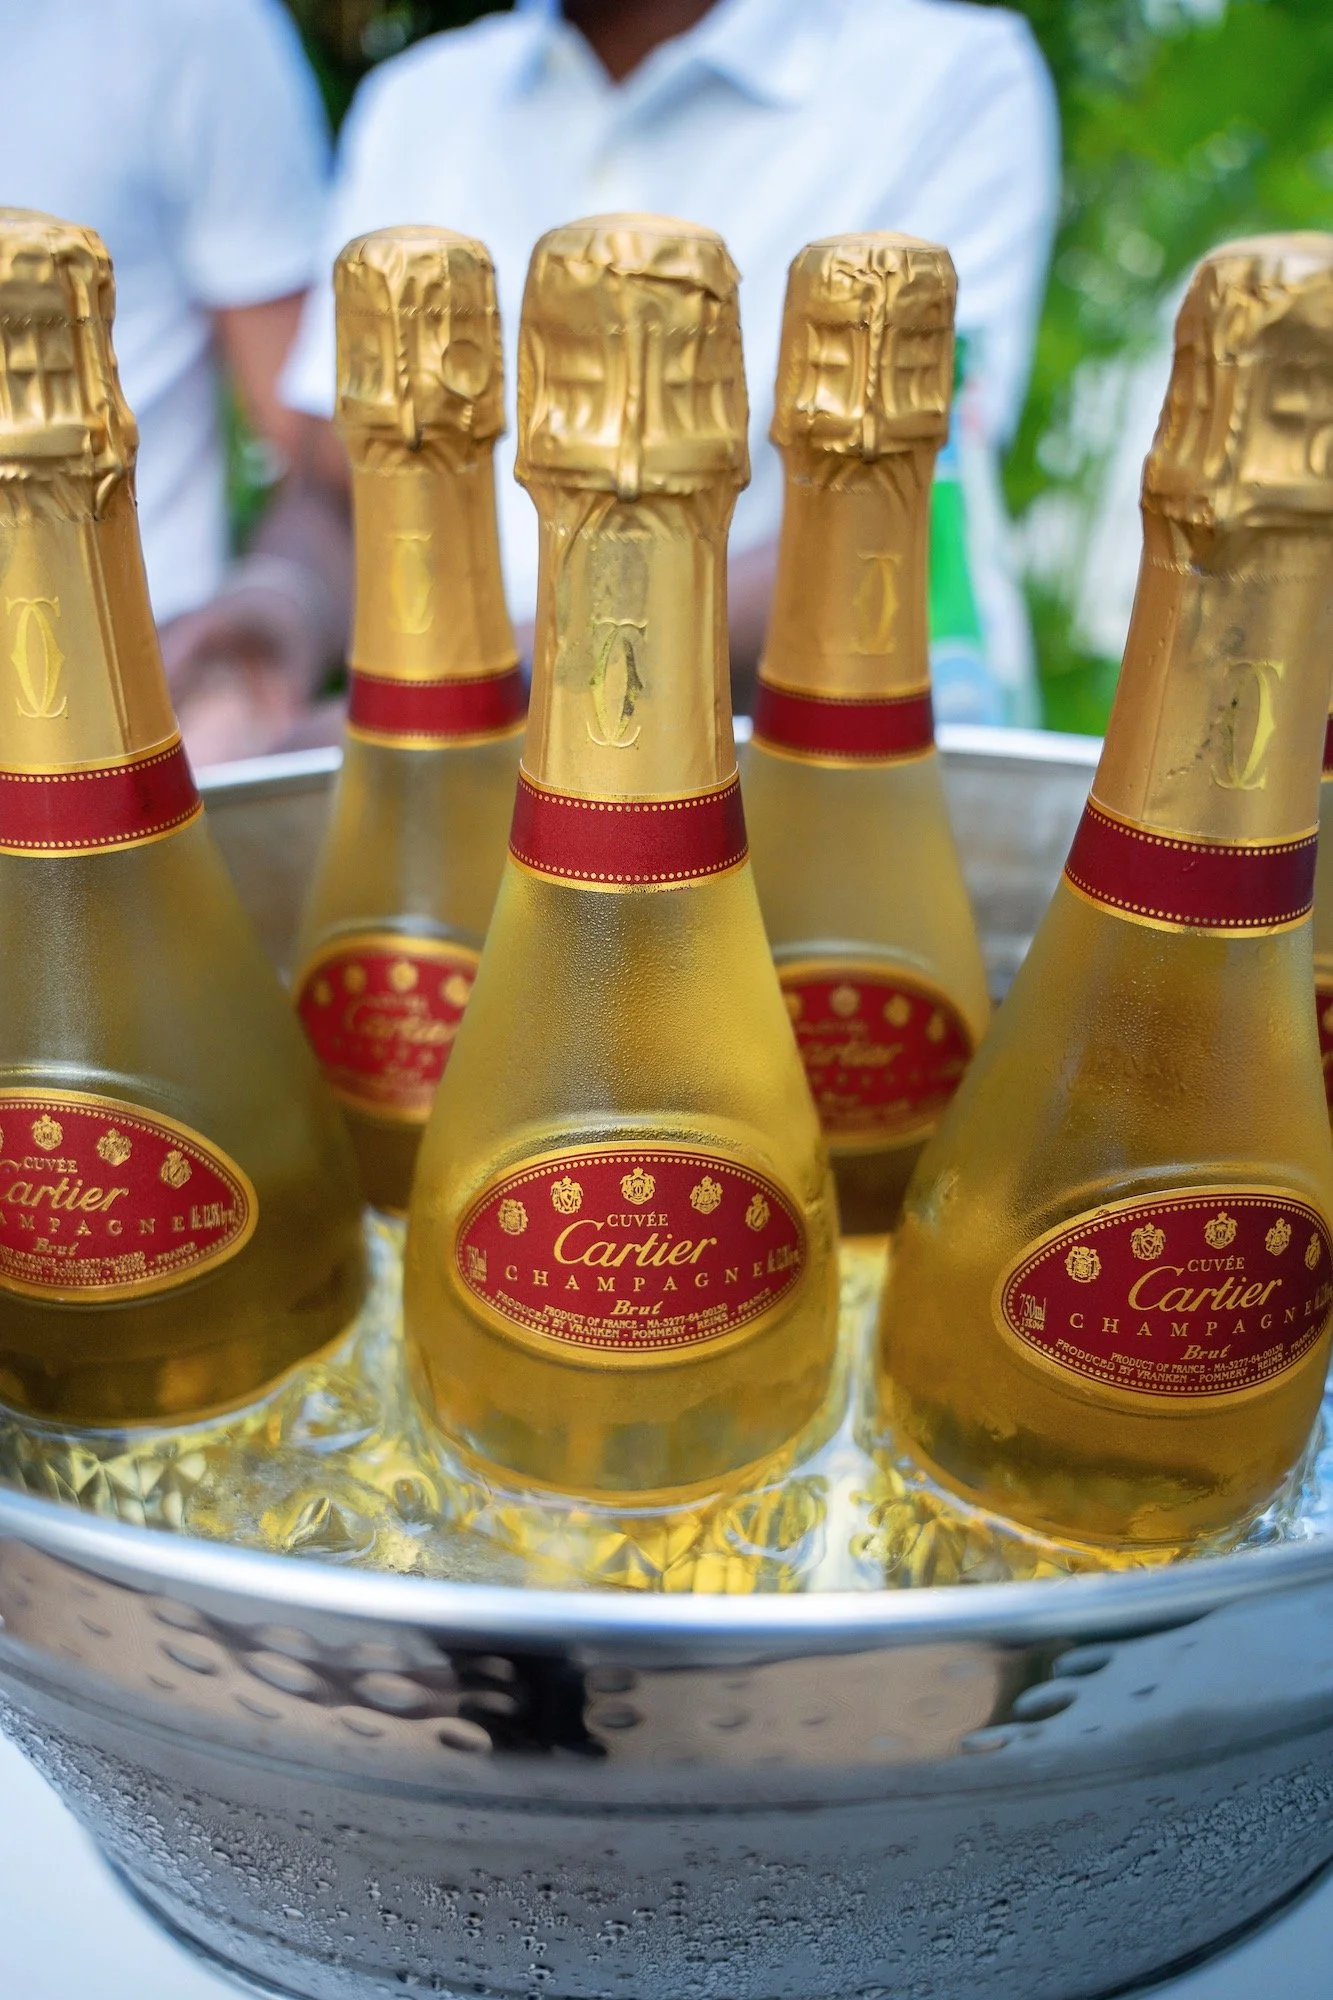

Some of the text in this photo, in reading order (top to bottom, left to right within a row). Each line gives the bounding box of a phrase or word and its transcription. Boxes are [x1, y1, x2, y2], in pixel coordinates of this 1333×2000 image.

[23, 1156, 78, 1173] CUVÉE
[0, 1211, 185, 1237] MPAGNE
[607, 1212, 668, 1227] CUVÉE
[33, 1237, 79, 1257] Brut
[554, 1219, 717, 1268] Cartier
[1187, 1256, 1245, 1272] CUVÉE
[505, 1262, 762, 1292] CHAMPAGNE
[1128, 1265, 1282, 1313] Cartier
[495, 1290, 549, 1323] PRODUCED
[552, 1318, 567, 1329] BY
[569, 1320, 619, 1337] VRANKEN
[632, 1325, 686, 1338] POMMERY
[697, 1312, 729, 1330] REIMS
[543, 1305, 585, 1324] PRODUCT
[587, 1317, 601, 1326] OF
[602, 1318, 637, 1329] FRANCE
[610, 1300, 663, 1315] Brut
[1019, 1292, 1047, 1321] 750ml
[1069, 1299, 1312, 1337] CHAMPAGNE
[1055, 1325, 1315, 1383] PRODUCED BY VRANKEN POMMERY REIMS FRANCE
[1110, 1351, 1155, 1371] PRODUCT
[1156, 1362, 1170, 1373] OF
[1171, 1364, 1206, 1374] FRANCE
[1180, 1344, 1232, 1360] Brut
